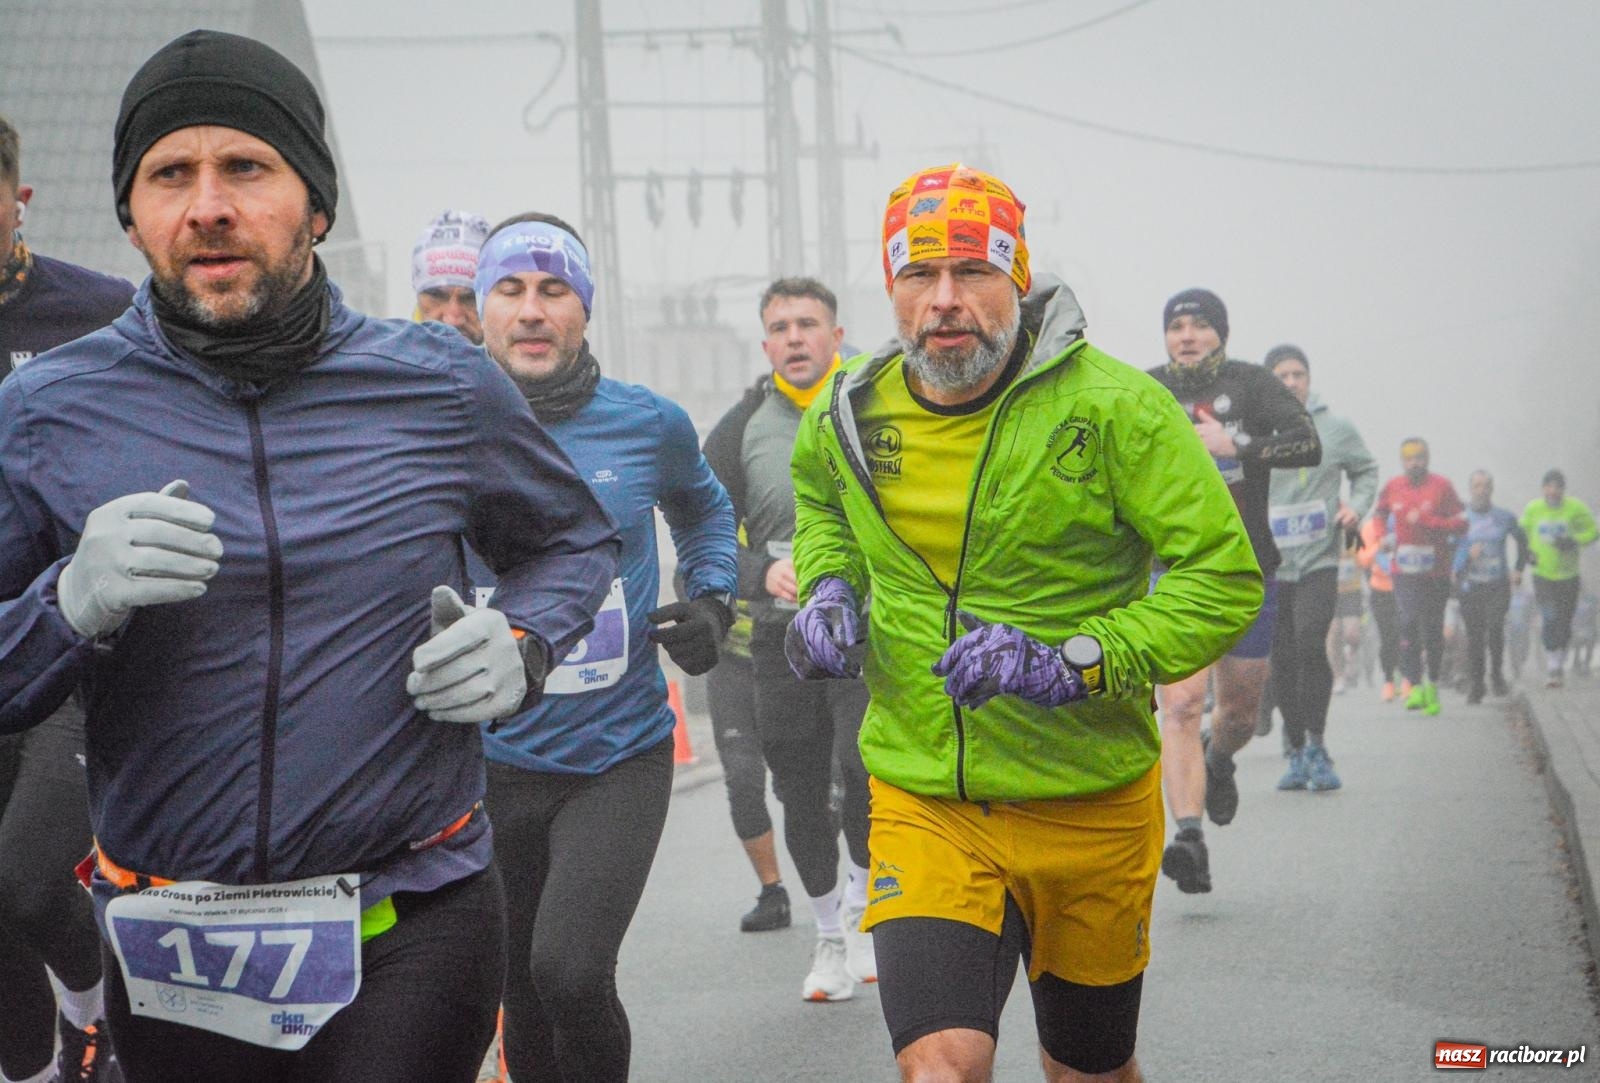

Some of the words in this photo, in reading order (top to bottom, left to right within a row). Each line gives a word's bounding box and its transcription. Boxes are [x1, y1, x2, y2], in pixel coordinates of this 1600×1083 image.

[516, 234, 549, 246] EKO
[161, 889, 193, 901] Cross
[195, 894, 212, 905] po
[213, 890, 251, 902] Ziemi
[252, 885, 337, 899] Pietrowickiej
[157, 927, 313, 999] 177
